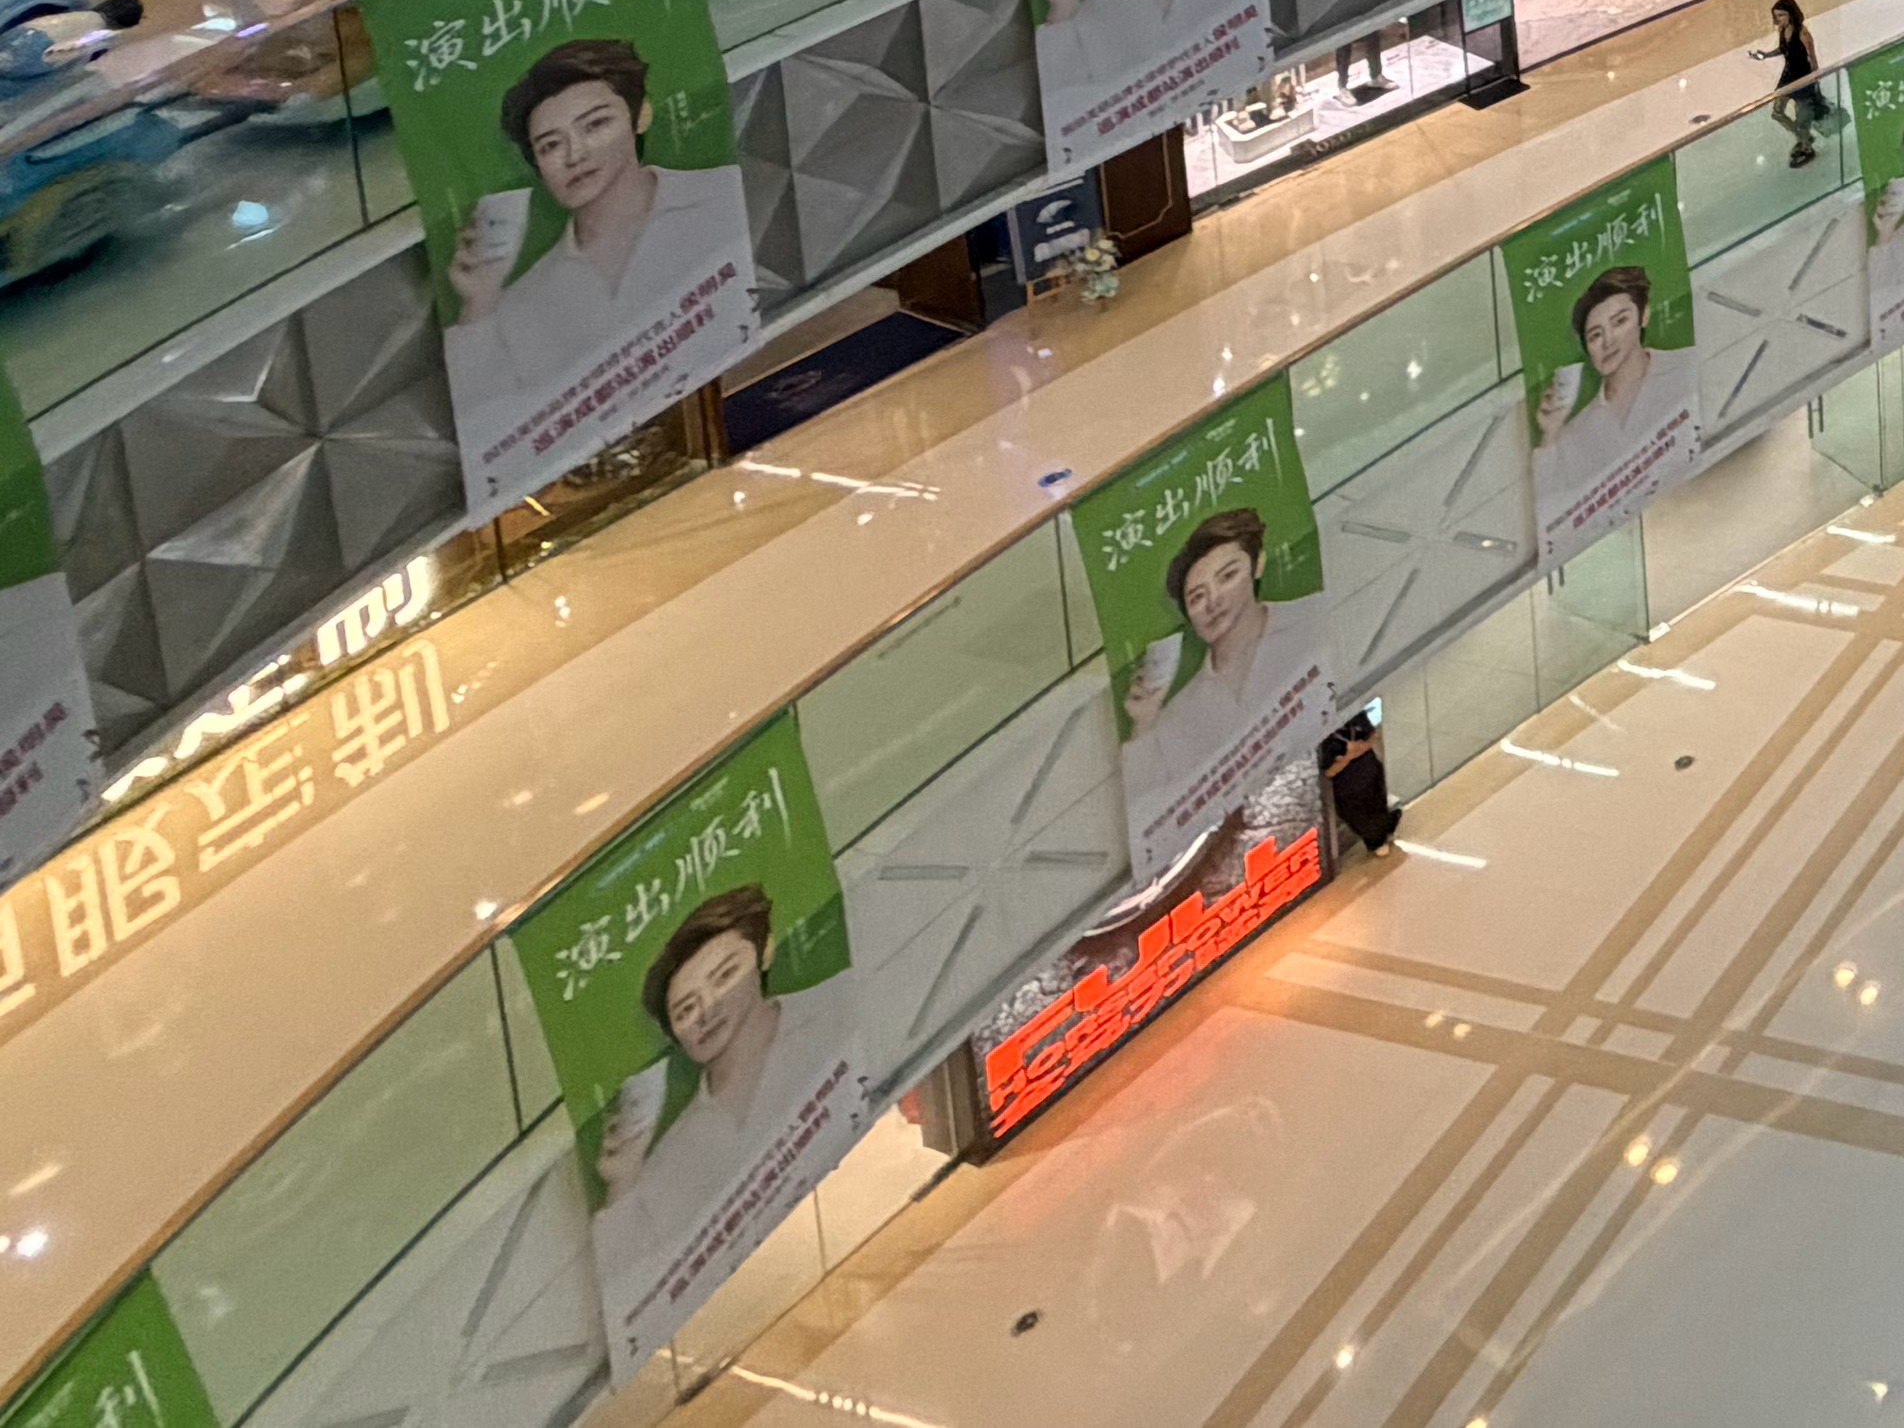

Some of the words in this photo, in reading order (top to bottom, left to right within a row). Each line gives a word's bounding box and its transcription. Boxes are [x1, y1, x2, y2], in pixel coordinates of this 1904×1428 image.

[1524, 191, 1663, 303] 演出顺利
[1102, 416, 1278, 571] 演出顺利
[555, 768, 792, 999] 演出顺利
[985, 827, 1316, 1090] FULL
[988, 842, 1318, 1112] HORSEPOWER
